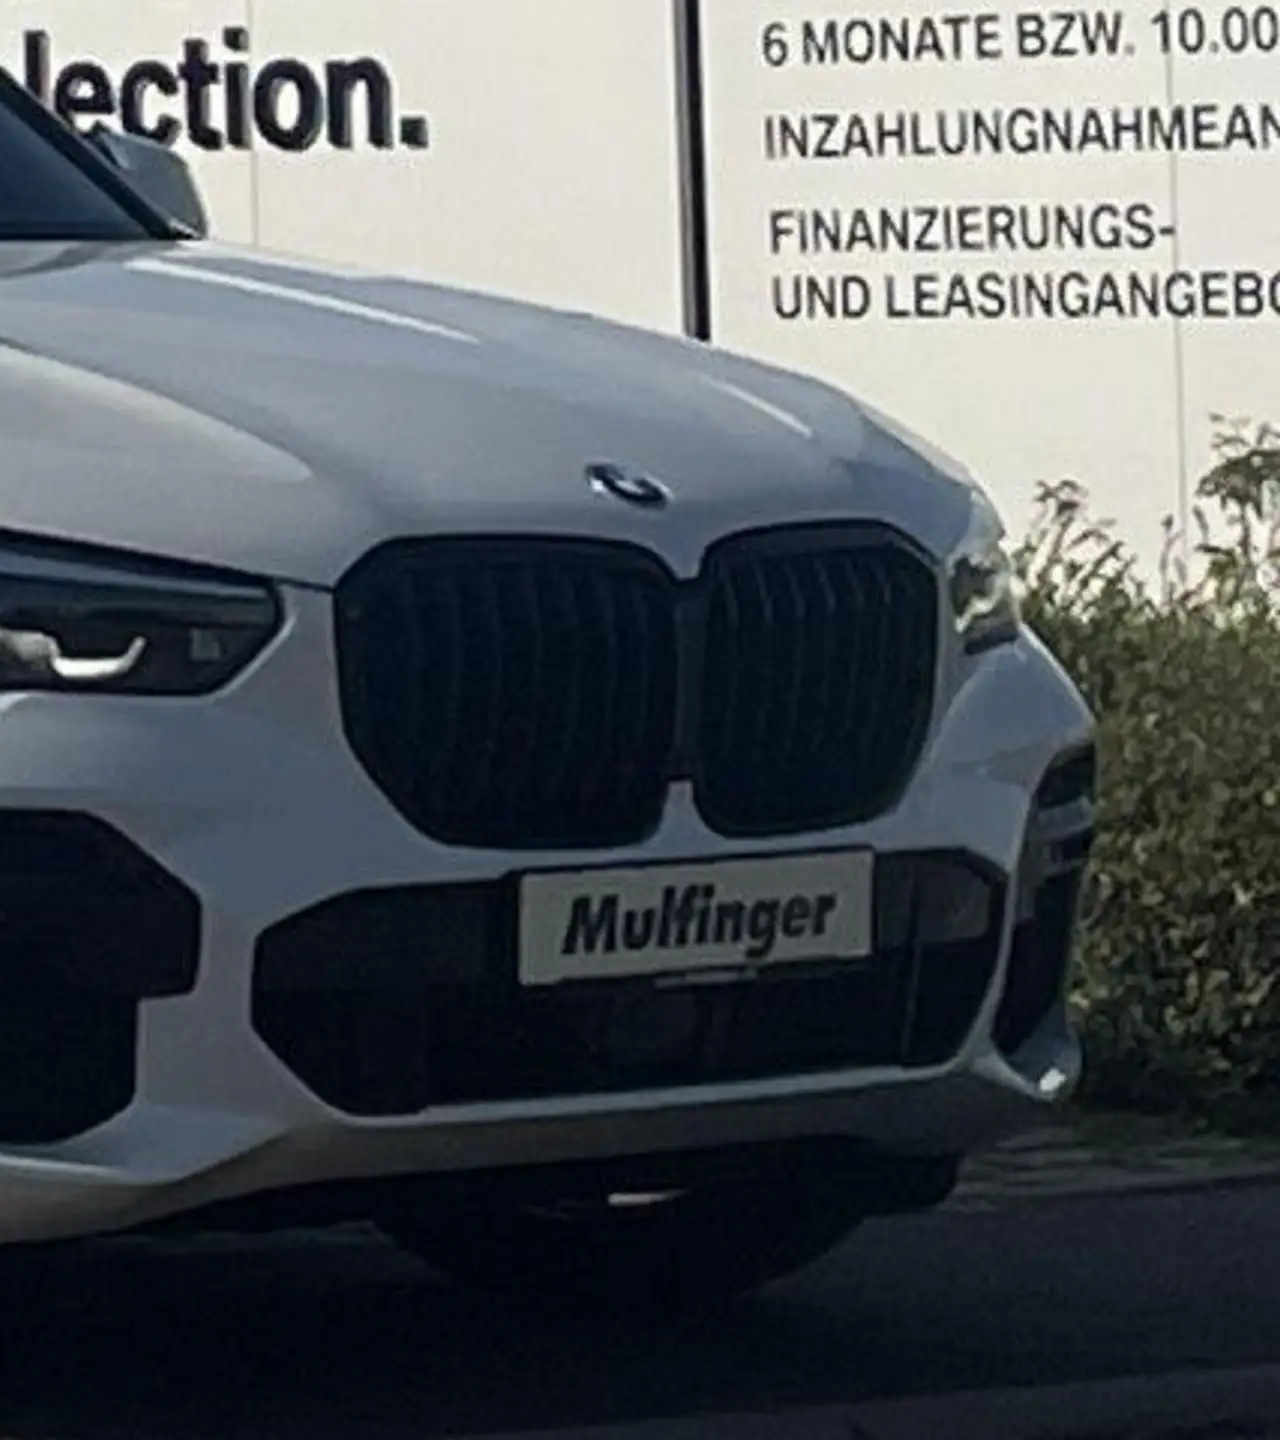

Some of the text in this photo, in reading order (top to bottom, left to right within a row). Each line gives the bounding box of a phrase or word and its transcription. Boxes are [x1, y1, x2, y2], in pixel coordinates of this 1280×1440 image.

[762, 5, 1279, 67] 6 MONATE BZW. 10.00
[23, 26, 429, 152] lection.
[770, 203, 1177, 254] FINANZIERUNGS-
[774, 275, 871, 320] UND
[561, 884, 837, 959] Mulfinger
